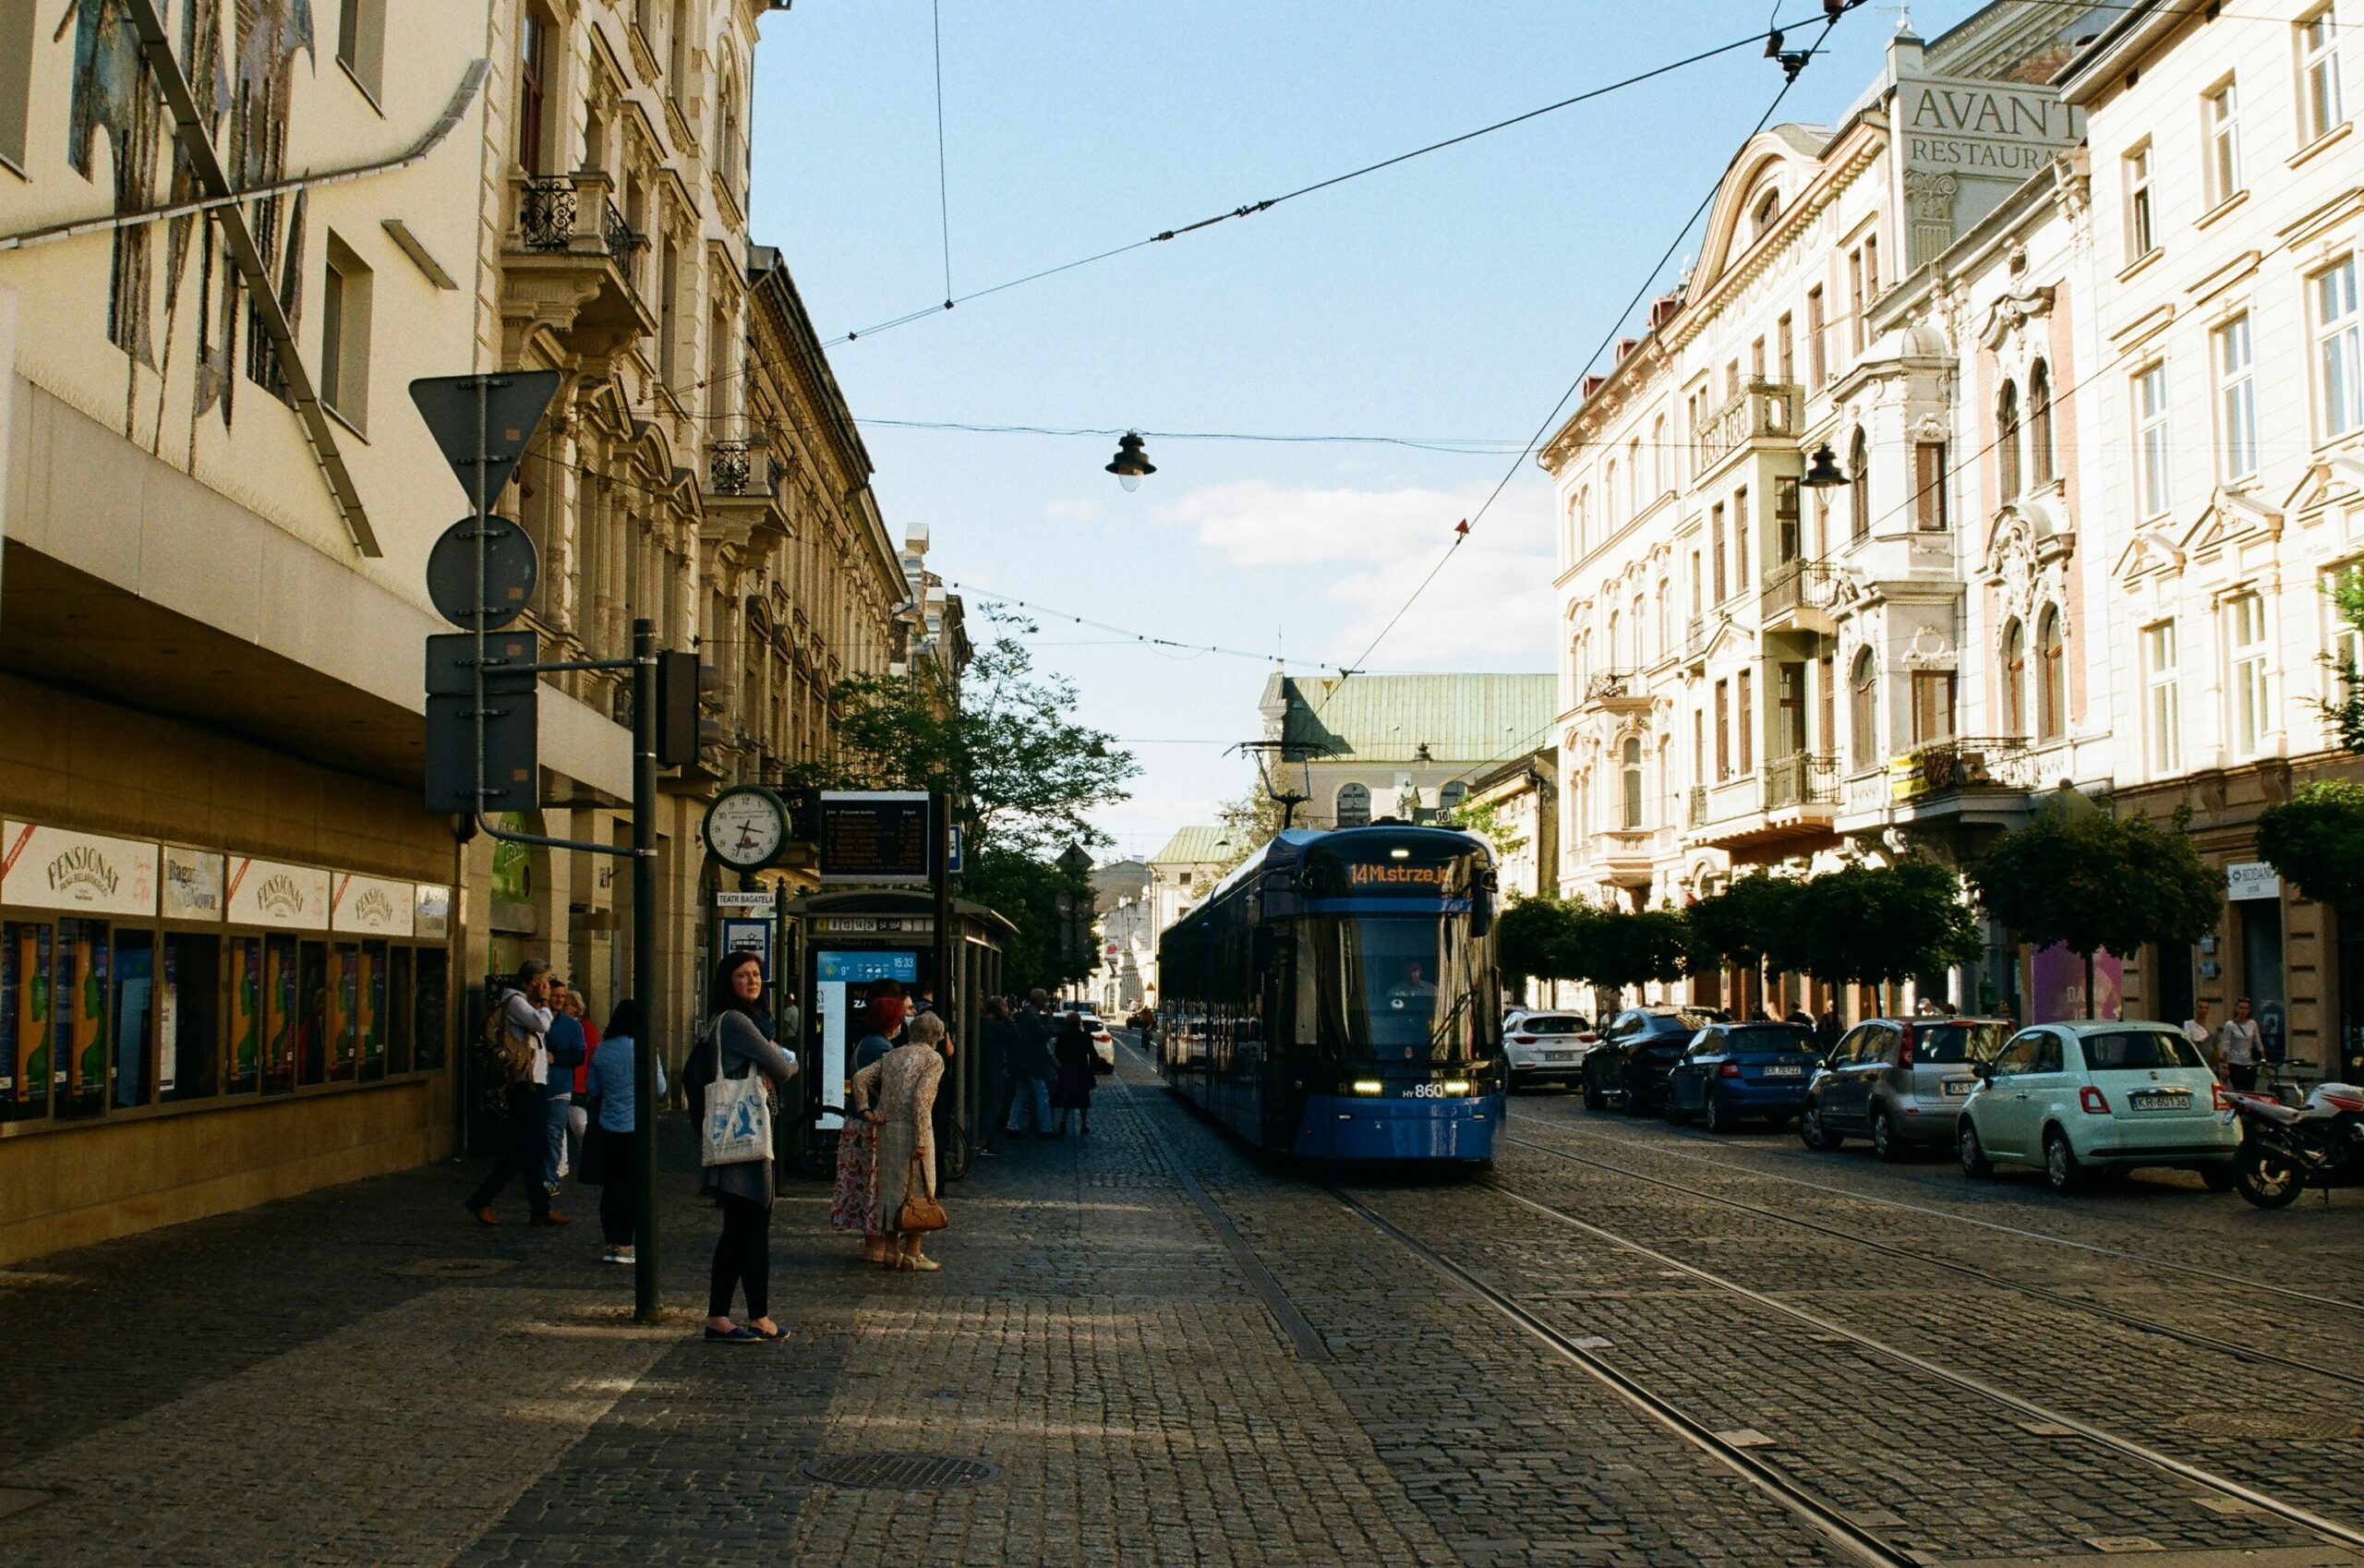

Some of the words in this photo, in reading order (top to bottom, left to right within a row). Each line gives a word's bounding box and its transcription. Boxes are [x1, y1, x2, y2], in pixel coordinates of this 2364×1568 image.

[1911, 89, 2080, 139] AVANT
[742, 797, 750, 806] 12
[718, 812, 727, 820] 10
[1350, 863, 1368, 884] 14
[719, 895, 739, 903] TEATR
[741, 895, 774, 904] BAGATELA
[894, 958, 913, 968] 15:33
[1952, 1083, 1964, 1092] KR
[2138, 1096, 2154, 1107] KR
